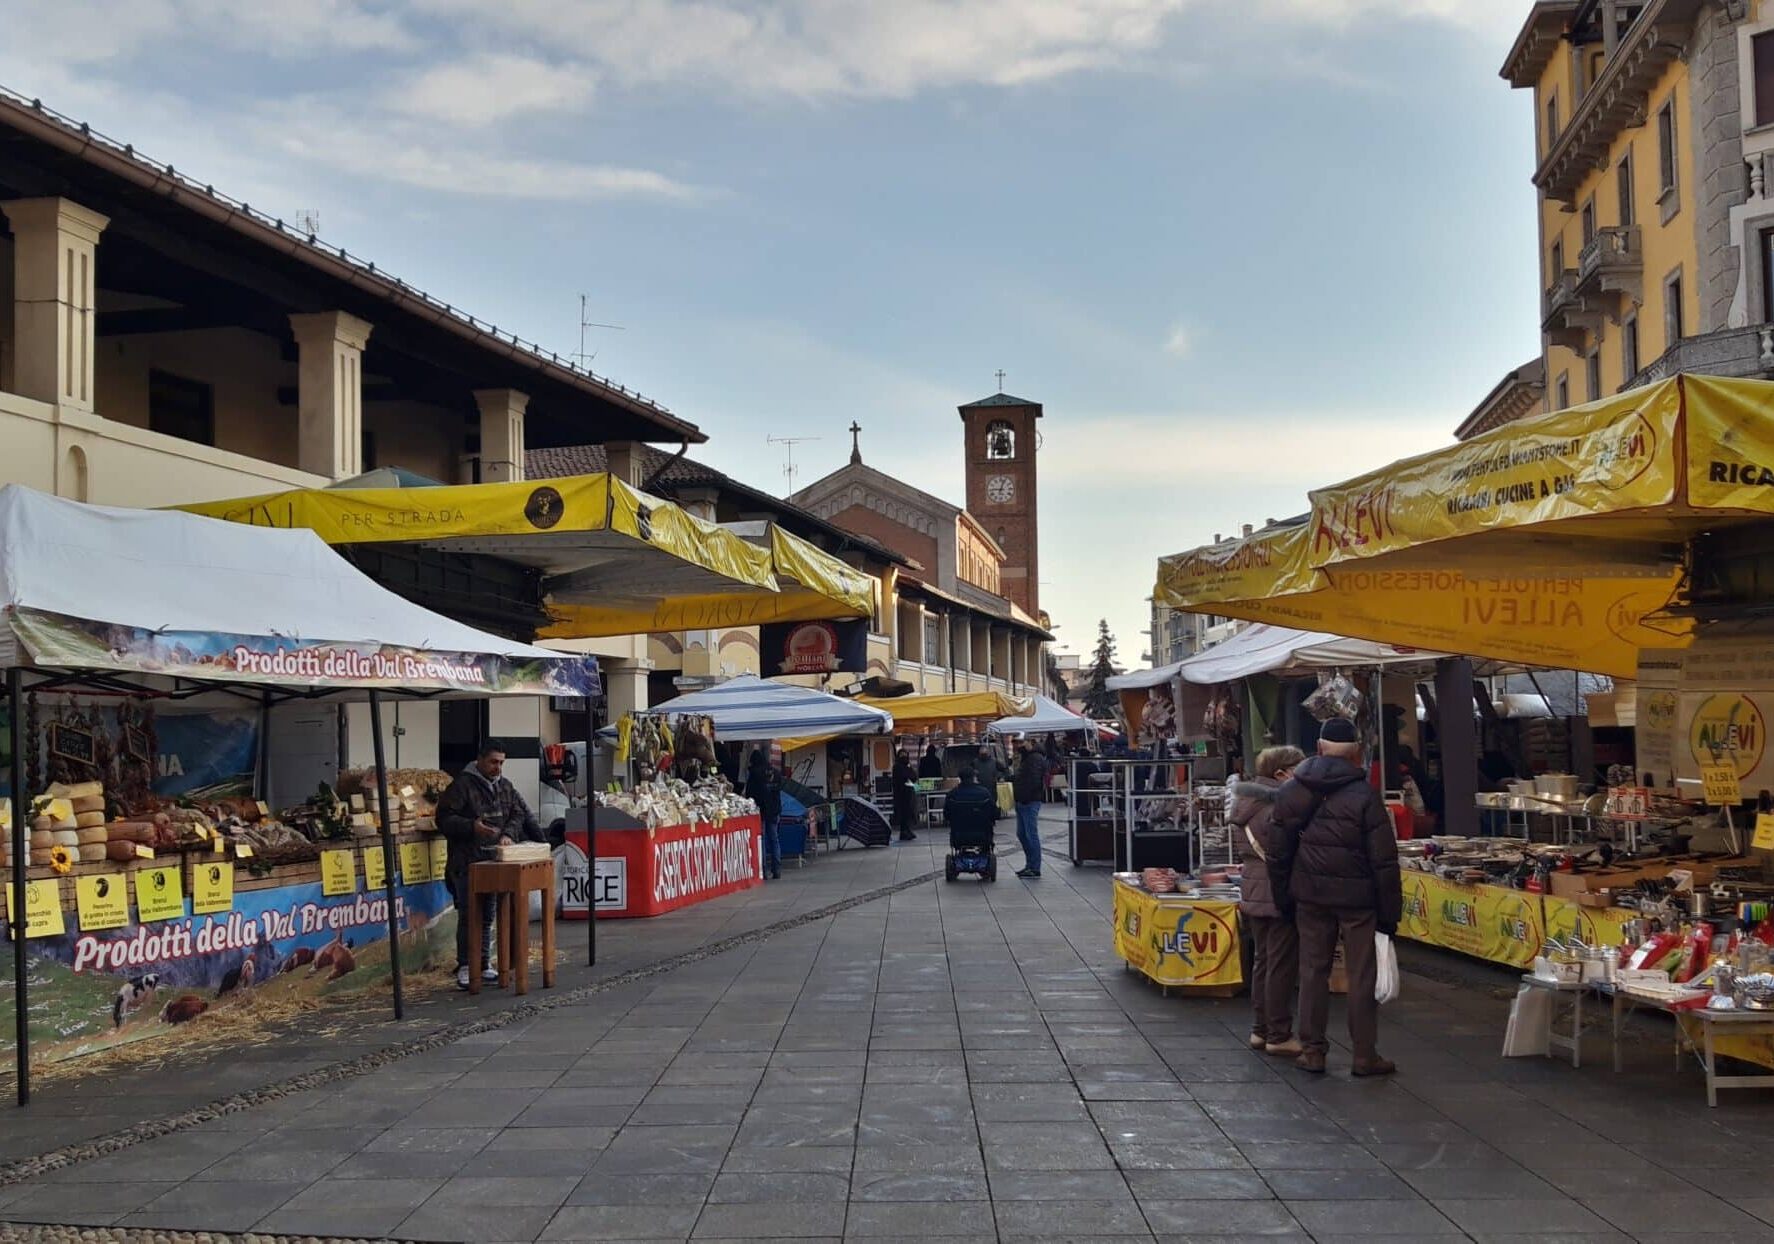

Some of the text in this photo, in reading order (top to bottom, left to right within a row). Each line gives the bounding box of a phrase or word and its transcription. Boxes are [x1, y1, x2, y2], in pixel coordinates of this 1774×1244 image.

[1495, 481, 1536, 506] CUCINE
[1540, 479, 1549, 498] A
[341, 512, 374, 528] PER
[387, 508, 466, 526] STRADA
[234, 646, 484, 684] Prodotti della Val Brembana
[75, 922, 191, 972] Prodotti
[196, 909, 260, 956] della
[263, 906, 298, 940] Val
